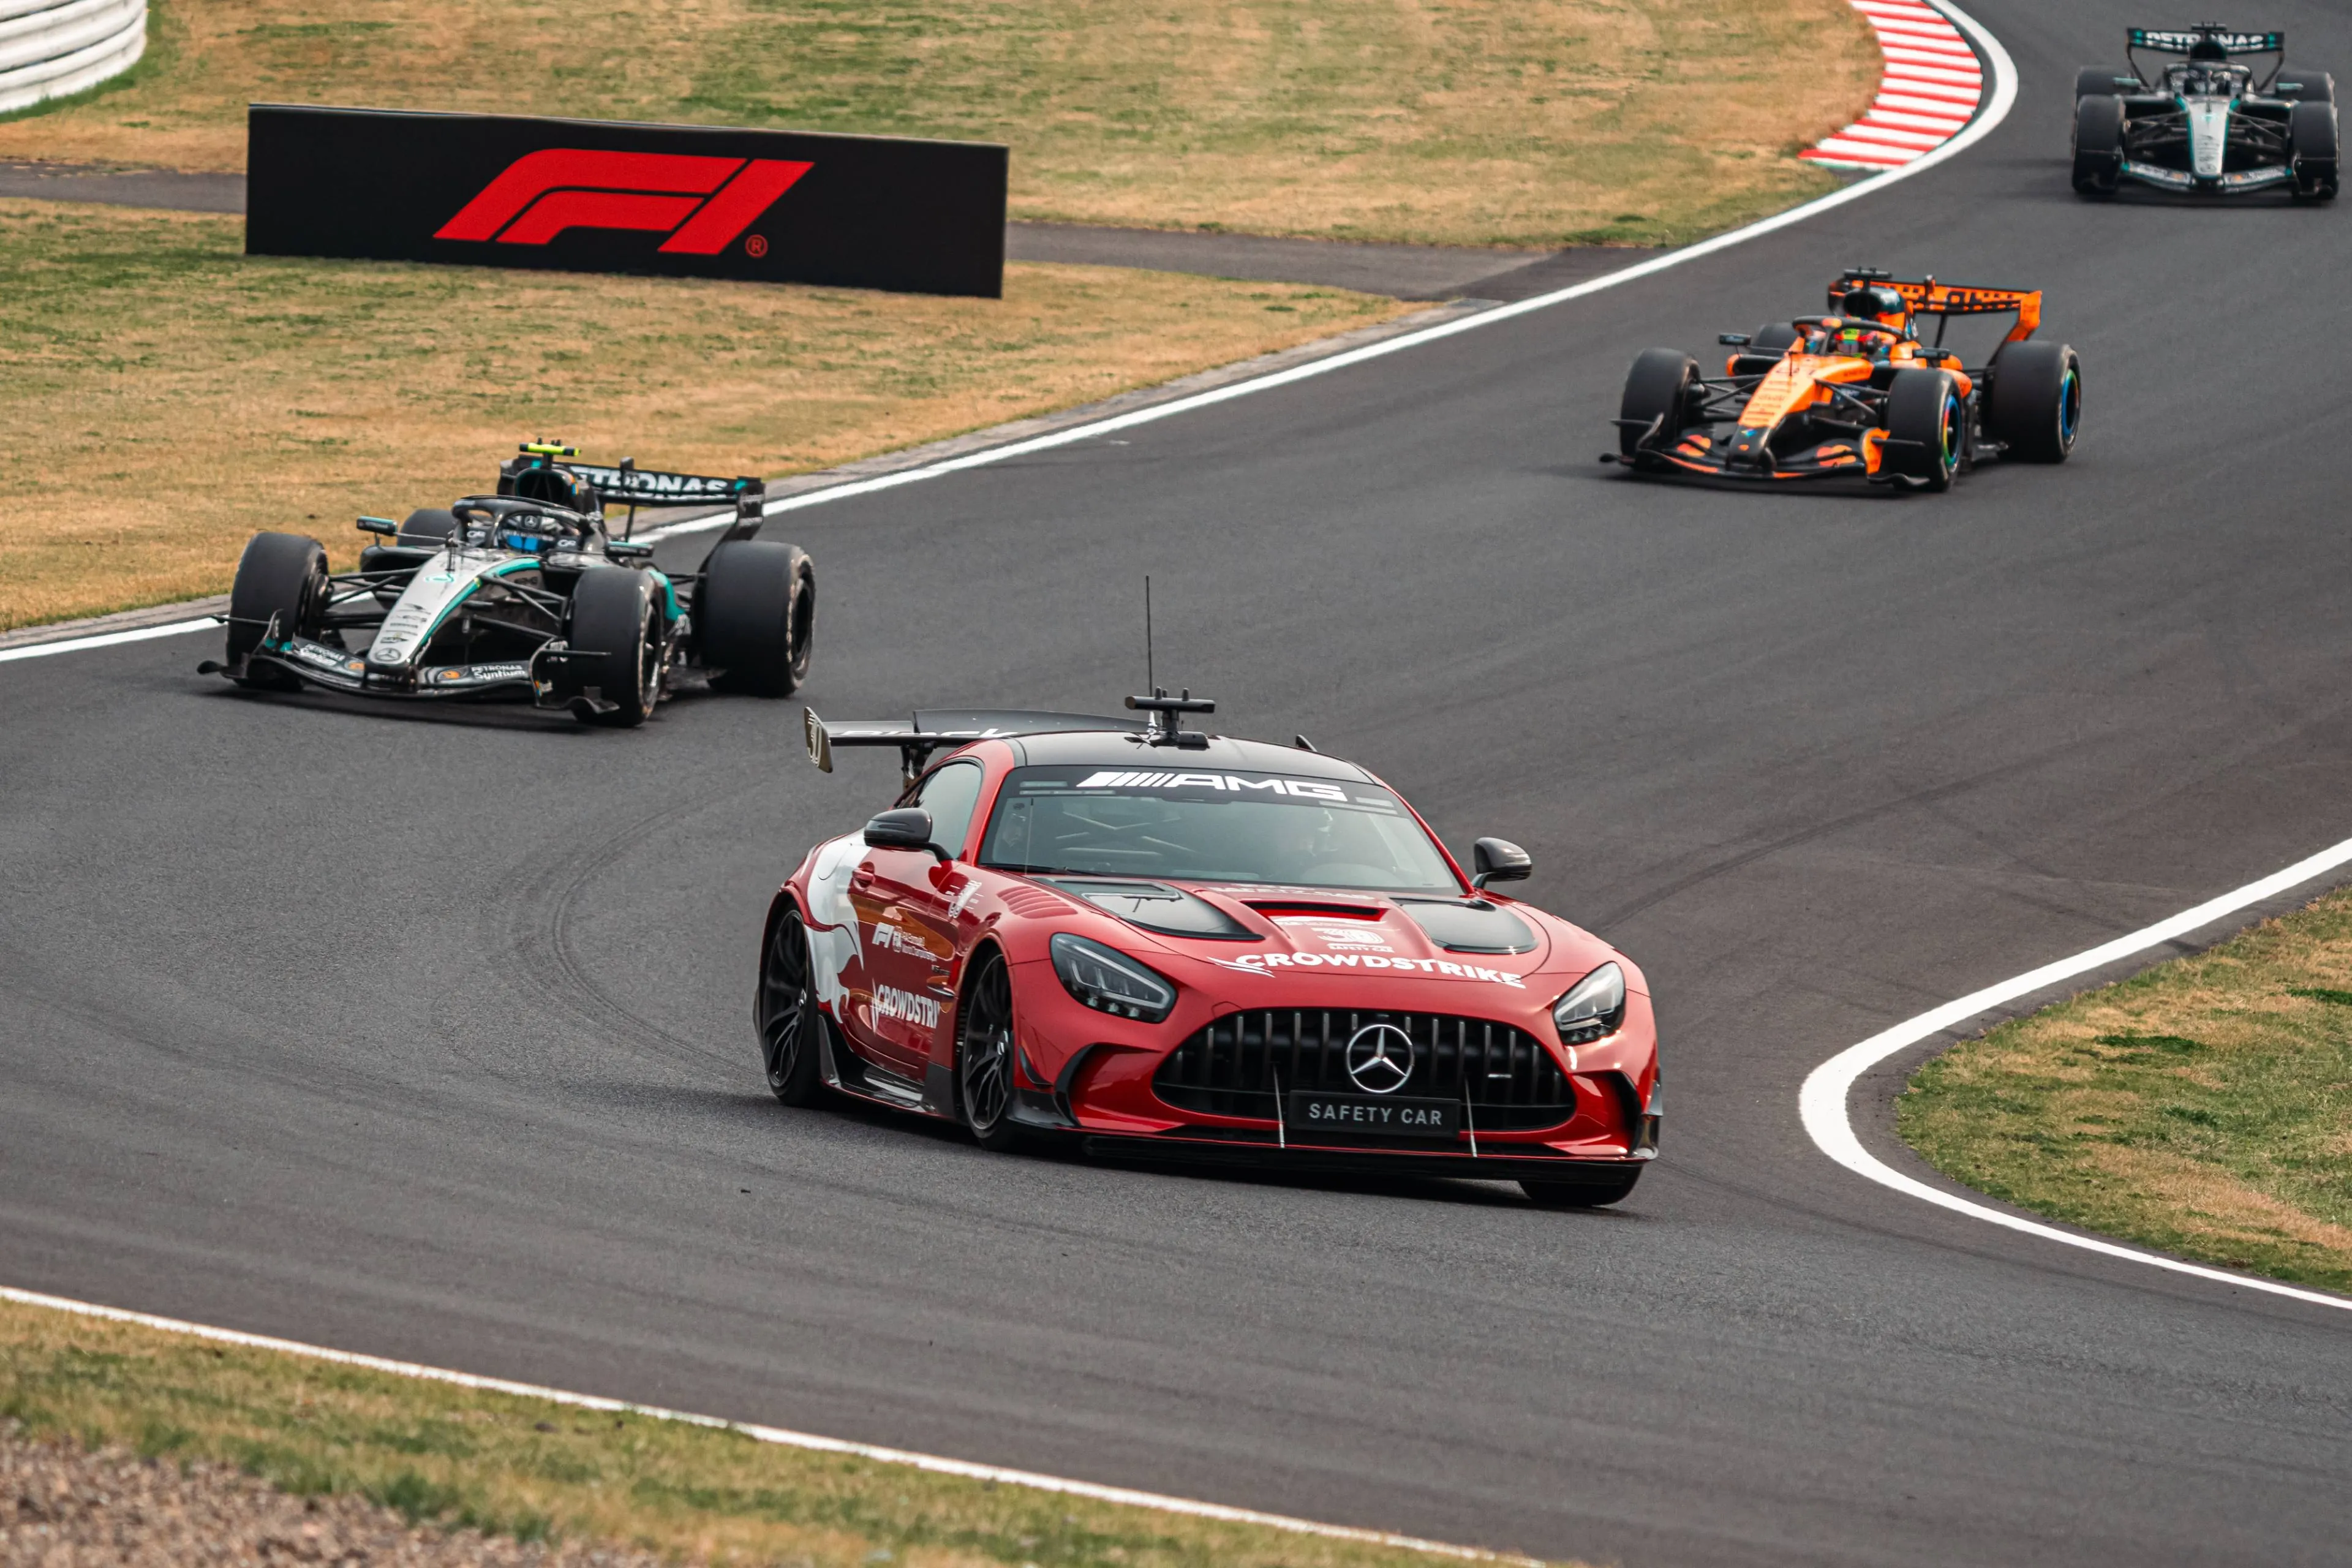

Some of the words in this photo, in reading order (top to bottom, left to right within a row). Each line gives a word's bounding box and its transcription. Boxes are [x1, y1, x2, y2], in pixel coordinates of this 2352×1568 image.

[471, 665, 523, 673] PETRONAS
[473, 670, 526, 680] Syntium
[1164, 774, 1348, 802] AMG
[1235, 951, 1526, 989] CROWDSTRIKE
[1308, 1103, 1393, 1123] SAFETY
[1400, 1108, 1442, 1126] CAR
